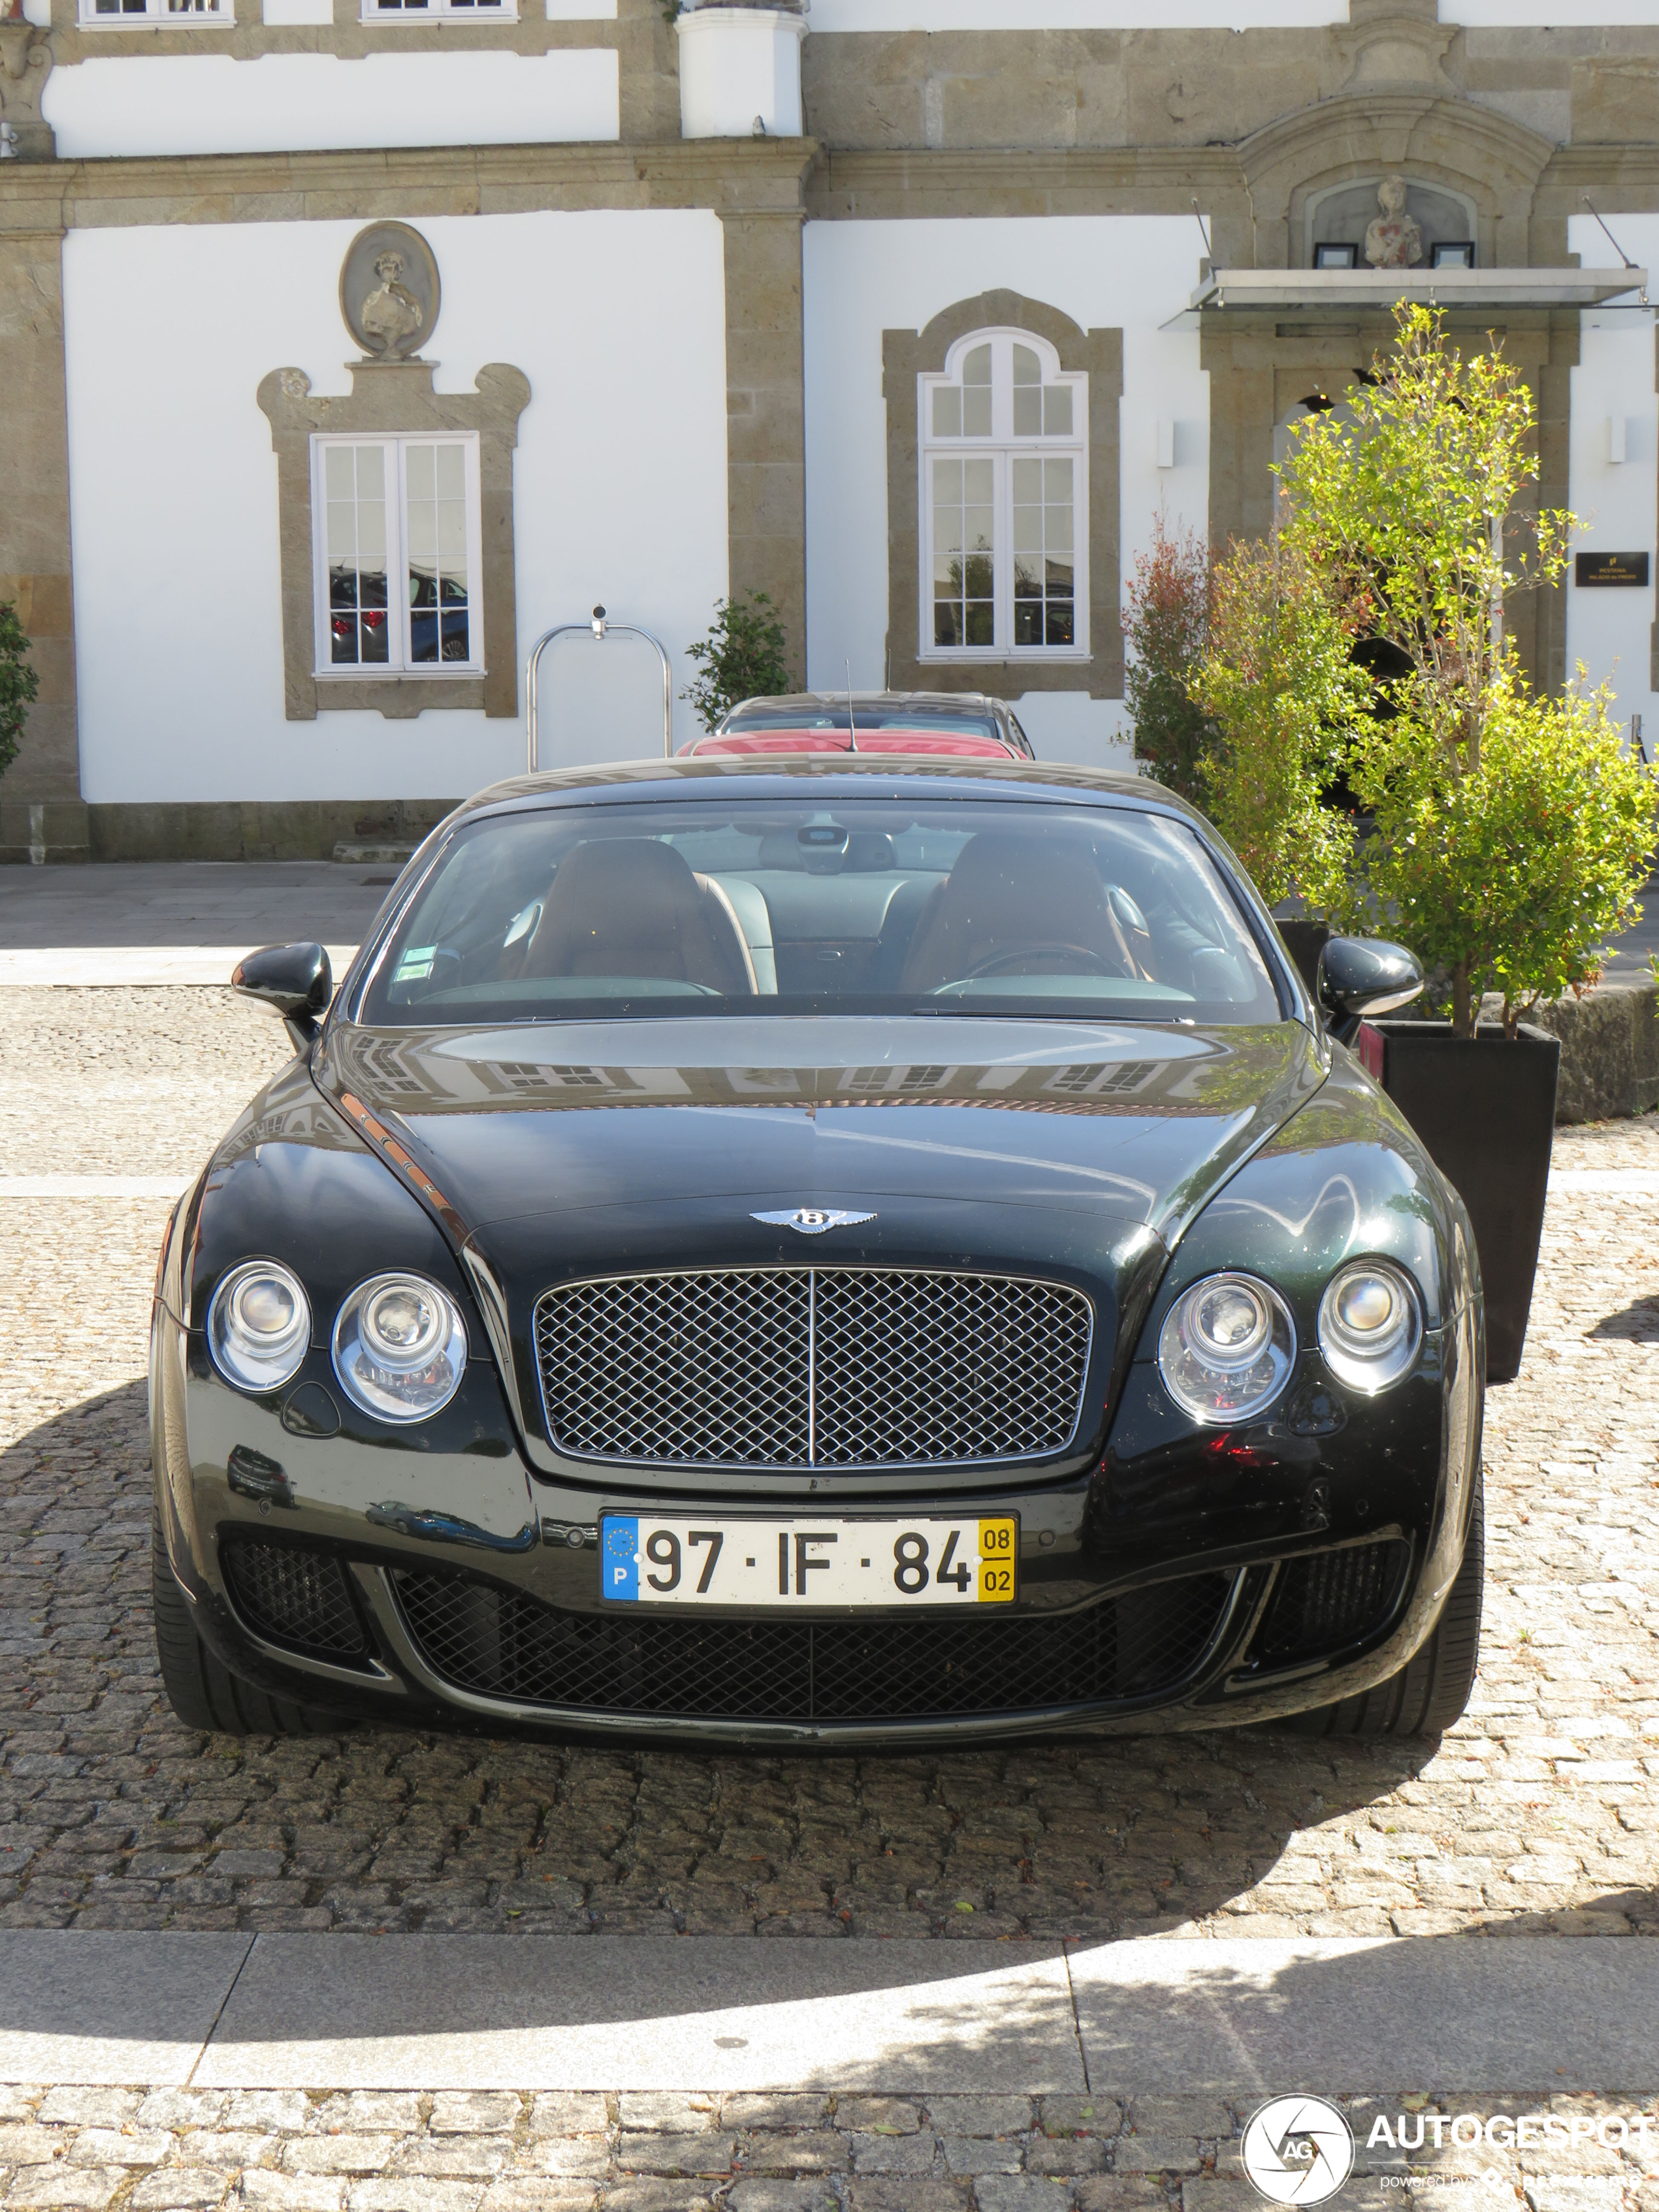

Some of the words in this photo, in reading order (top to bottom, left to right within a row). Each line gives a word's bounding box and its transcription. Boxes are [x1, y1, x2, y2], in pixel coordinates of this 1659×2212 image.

[984, 1529, 1010, 1550] 08
[614, 1567, 628, 1585] P
[985, 1571, 1010, 1592] 02
